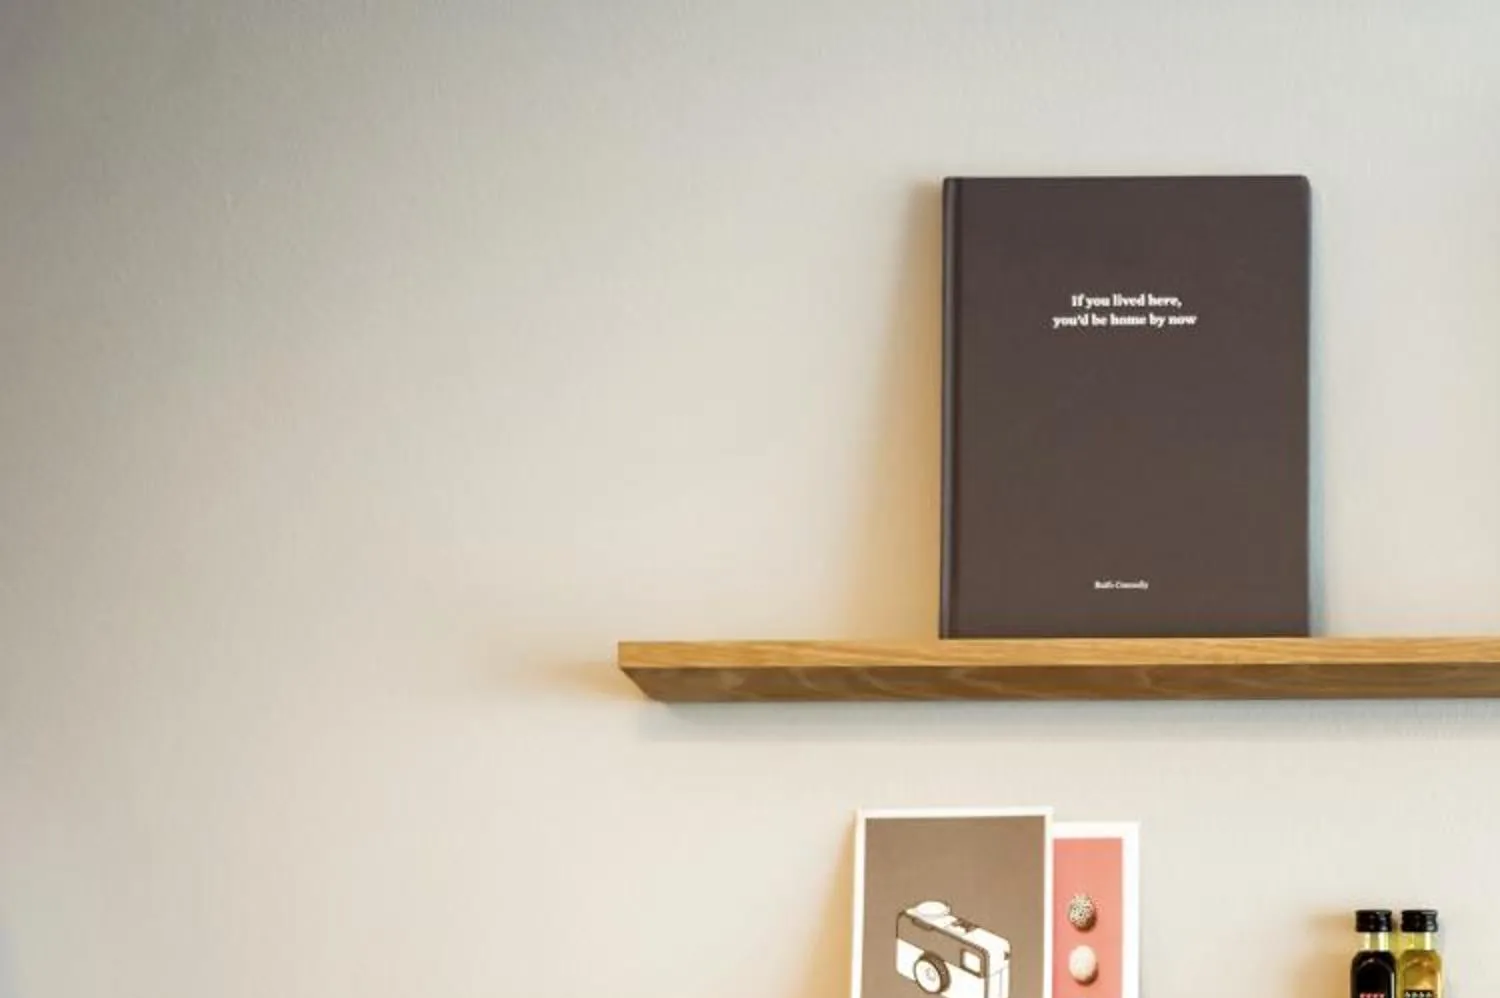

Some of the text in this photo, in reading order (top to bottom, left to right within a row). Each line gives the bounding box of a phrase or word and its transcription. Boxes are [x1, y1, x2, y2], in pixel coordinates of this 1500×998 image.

[1071, 293, 1183, 309] If you lived here,
[1091, 313, 1108, 326] be
[1110, 313, 1147, 326] home
[1150, 313, 1166, 328] by
[1168, 316, 1197, 325] now
